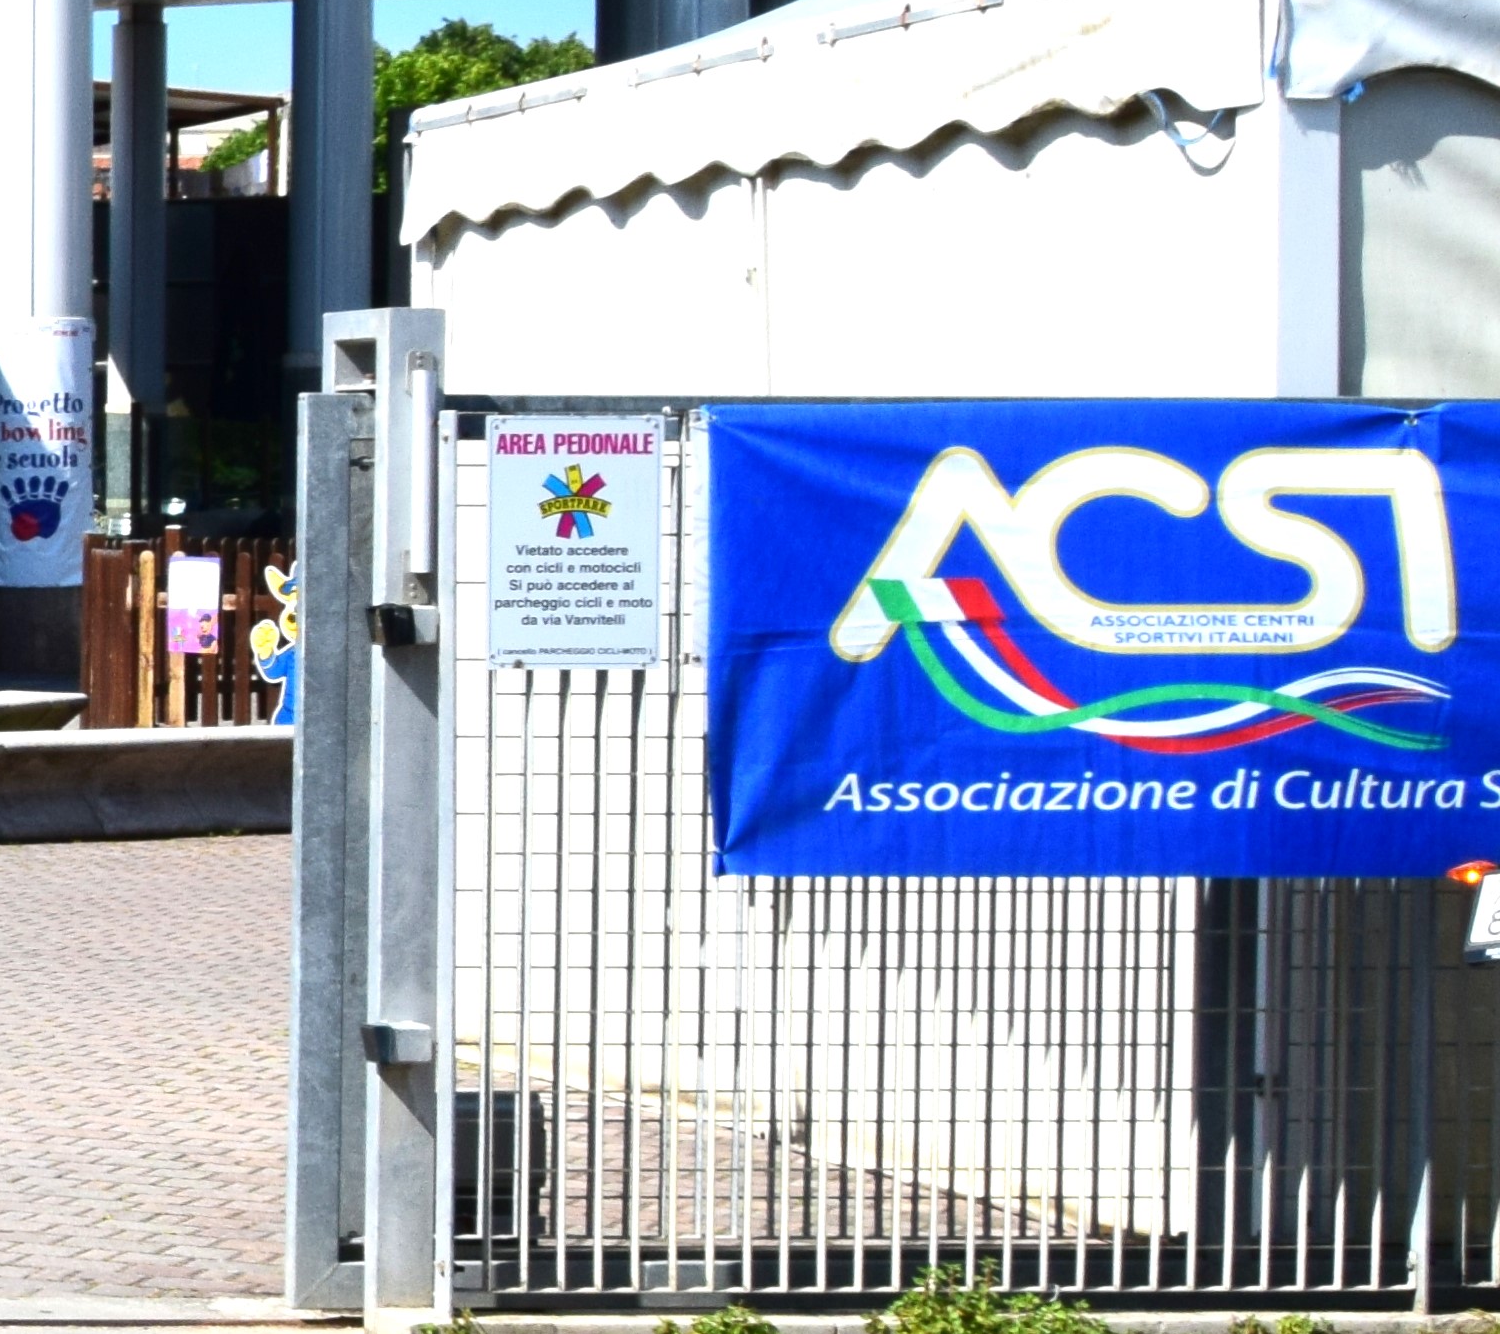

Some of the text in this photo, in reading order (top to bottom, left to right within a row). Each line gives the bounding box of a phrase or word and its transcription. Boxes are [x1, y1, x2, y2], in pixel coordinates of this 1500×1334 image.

[1, 419, 88, 452] bowling
[496, 433, 654, 454] AREA PEDONALE
[7, 446, 79, 470] scuola
[540, 497, 607, 515] SPORTPARK
[515, 545, 629, 556] Vietato accedere
[828, 445, 1457, 663] ACSI
[506, 562, 641, 573] con cicli e motocicli
[527, 579, 553, 593] può
[557, 579, 619, 591] accedere
[622, 580, 634, 591] al
[494, 597, 653, 611] parcheggio cicli e moto
[521, 614, 626, 626] da via Vanvitelli
[1090, 614, 1314, 628] ASSOCIAZIONE CENTRI
[1114, 631, 1294, 644] SPORTIVI ITALIANI
[823, 771, 1198, 812] Associazione
[1209, 768, 1259, 810] di
[1272, 768, 1465, 810] Cultura
